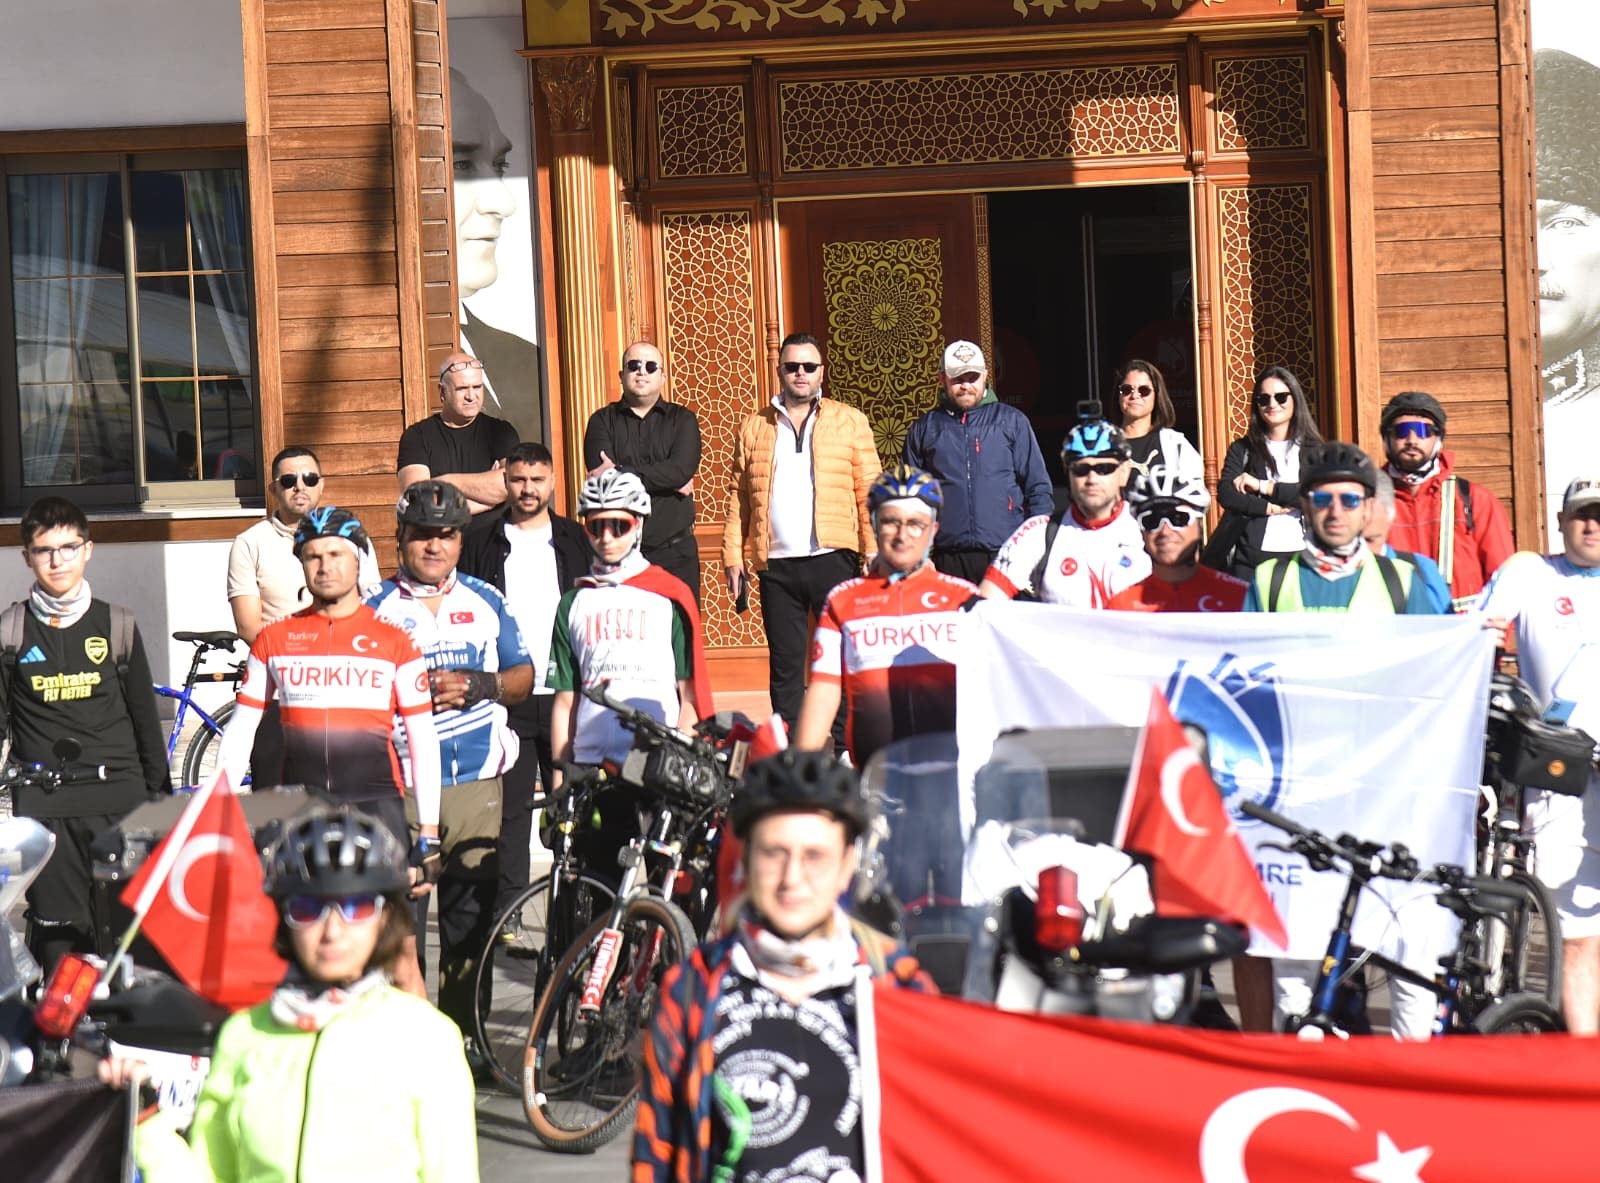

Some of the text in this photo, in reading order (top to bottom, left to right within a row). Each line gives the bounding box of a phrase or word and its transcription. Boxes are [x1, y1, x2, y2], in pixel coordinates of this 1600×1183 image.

[850, 619, 957, 649] TÜRKİYE
[31, 672, 101, 691] Emirates
[276, 661, 384, 689] TÜRKİYE
[43, 688, 60, 703] FLY
